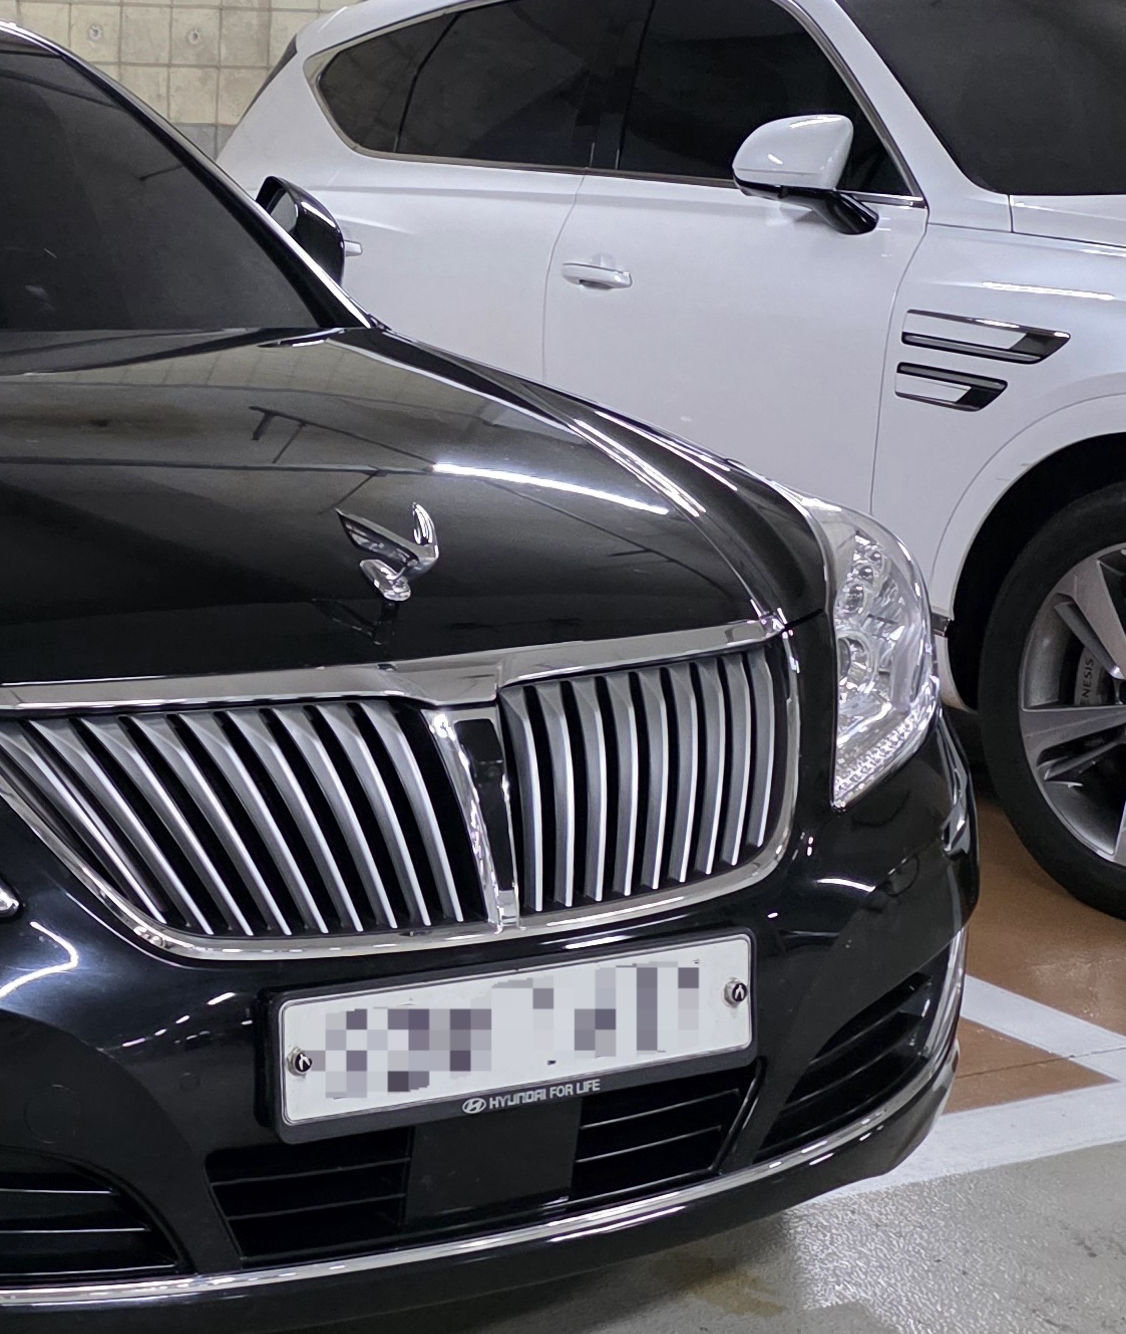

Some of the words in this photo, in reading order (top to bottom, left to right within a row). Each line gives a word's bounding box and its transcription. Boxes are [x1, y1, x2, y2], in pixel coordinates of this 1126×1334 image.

[1080, 658, 1094, 705] ENESIS
[489, 1088, 547, 1109] HYUNDAI
[549, 1084, 573, 1099] FOR
[576, 1079, 601, 1094] LIFE
